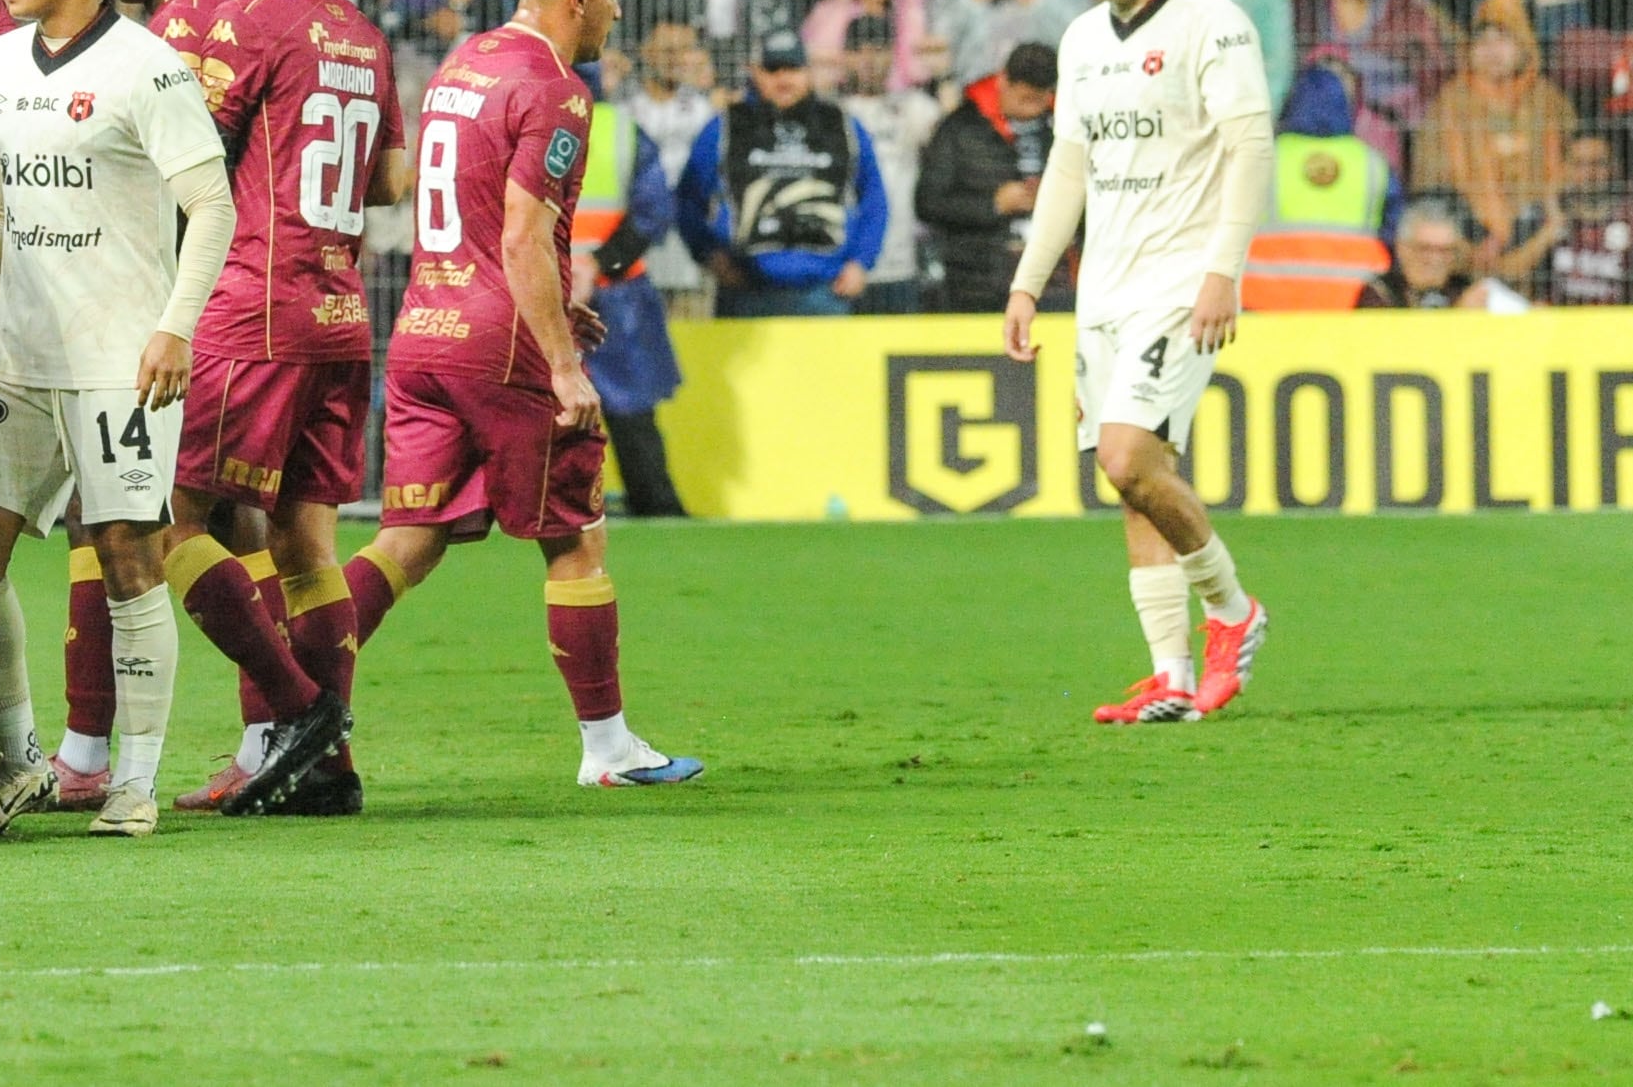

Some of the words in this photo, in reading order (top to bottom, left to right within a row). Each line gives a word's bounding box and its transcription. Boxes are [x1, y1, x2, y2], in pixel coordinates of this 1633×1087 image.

[33, 96, 59, 112] BAC
[1099, 110, 1164, 140] kölbi
[16, 153, 93, 189] kölbi
[300, 92, 381, 236] 20
[418, 120, 462, 253] 8
[12, 224, 103, 252] medismart
[325, 294, 361, 310] STAR
[330, 308, 369, 324] CARS
[409, 307, 462, 323] STAR
[409, 320, 471, 338] CARS
[1140, 335, 1169, 379] 4
[97, 406, 153, 463] 14
[1077, 368, 1633, 512] OODLIF
